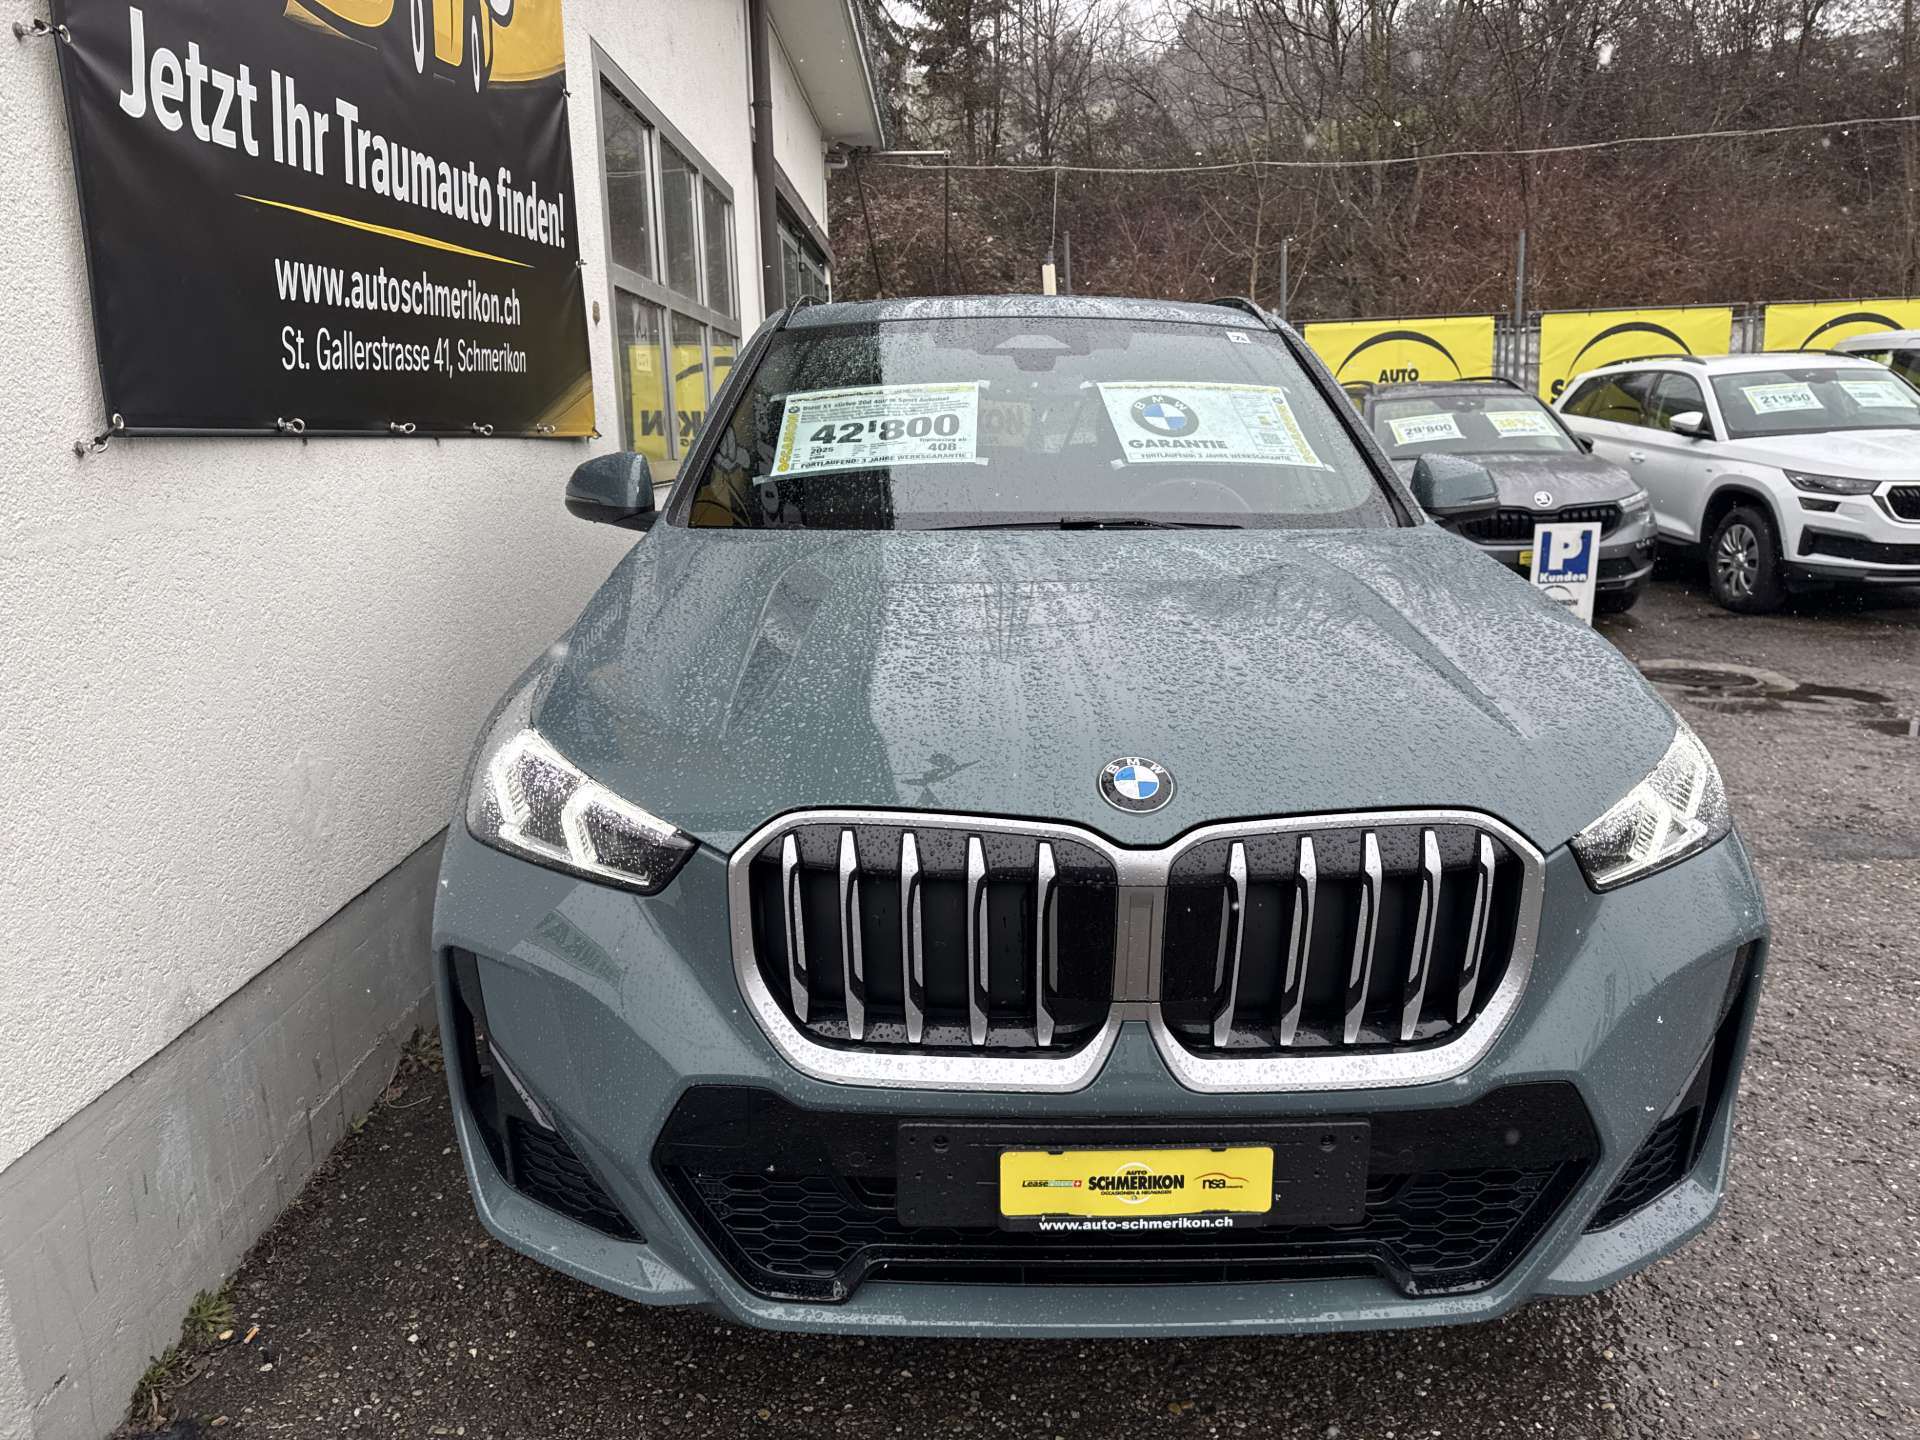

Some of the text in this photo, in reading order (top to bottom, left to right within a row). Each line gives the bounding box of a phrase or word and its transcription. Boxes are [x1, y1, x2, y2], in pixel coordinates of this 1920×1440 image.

[118, 6, 566, 249] Jetzt Ihr Traumauto finden!
[274, 258, 522, 327] www.autoschmerikon.ch
[281, 325, 527, 379] St. Gallerstrasse 41, Schmerikon
[1378, 368, 1420, 383] AUTO
[1134, 395, 1188, 412] BMW
[810, 413, 960, 445] 42'800
[1128, 438, 1229, 450] GARANTIE
[1548, 529, 1583, 571] P
[1539, 570, 1587, 583] Kunden
[1104, 757, 1166, 775] BMW
[1088, 1174, 1185, 1191] SCHMERIKON
[1202, 1177, 1226, 1190] nsa
[1039, 1217, 1234, 1231] www.auto-schmerikon.ch
